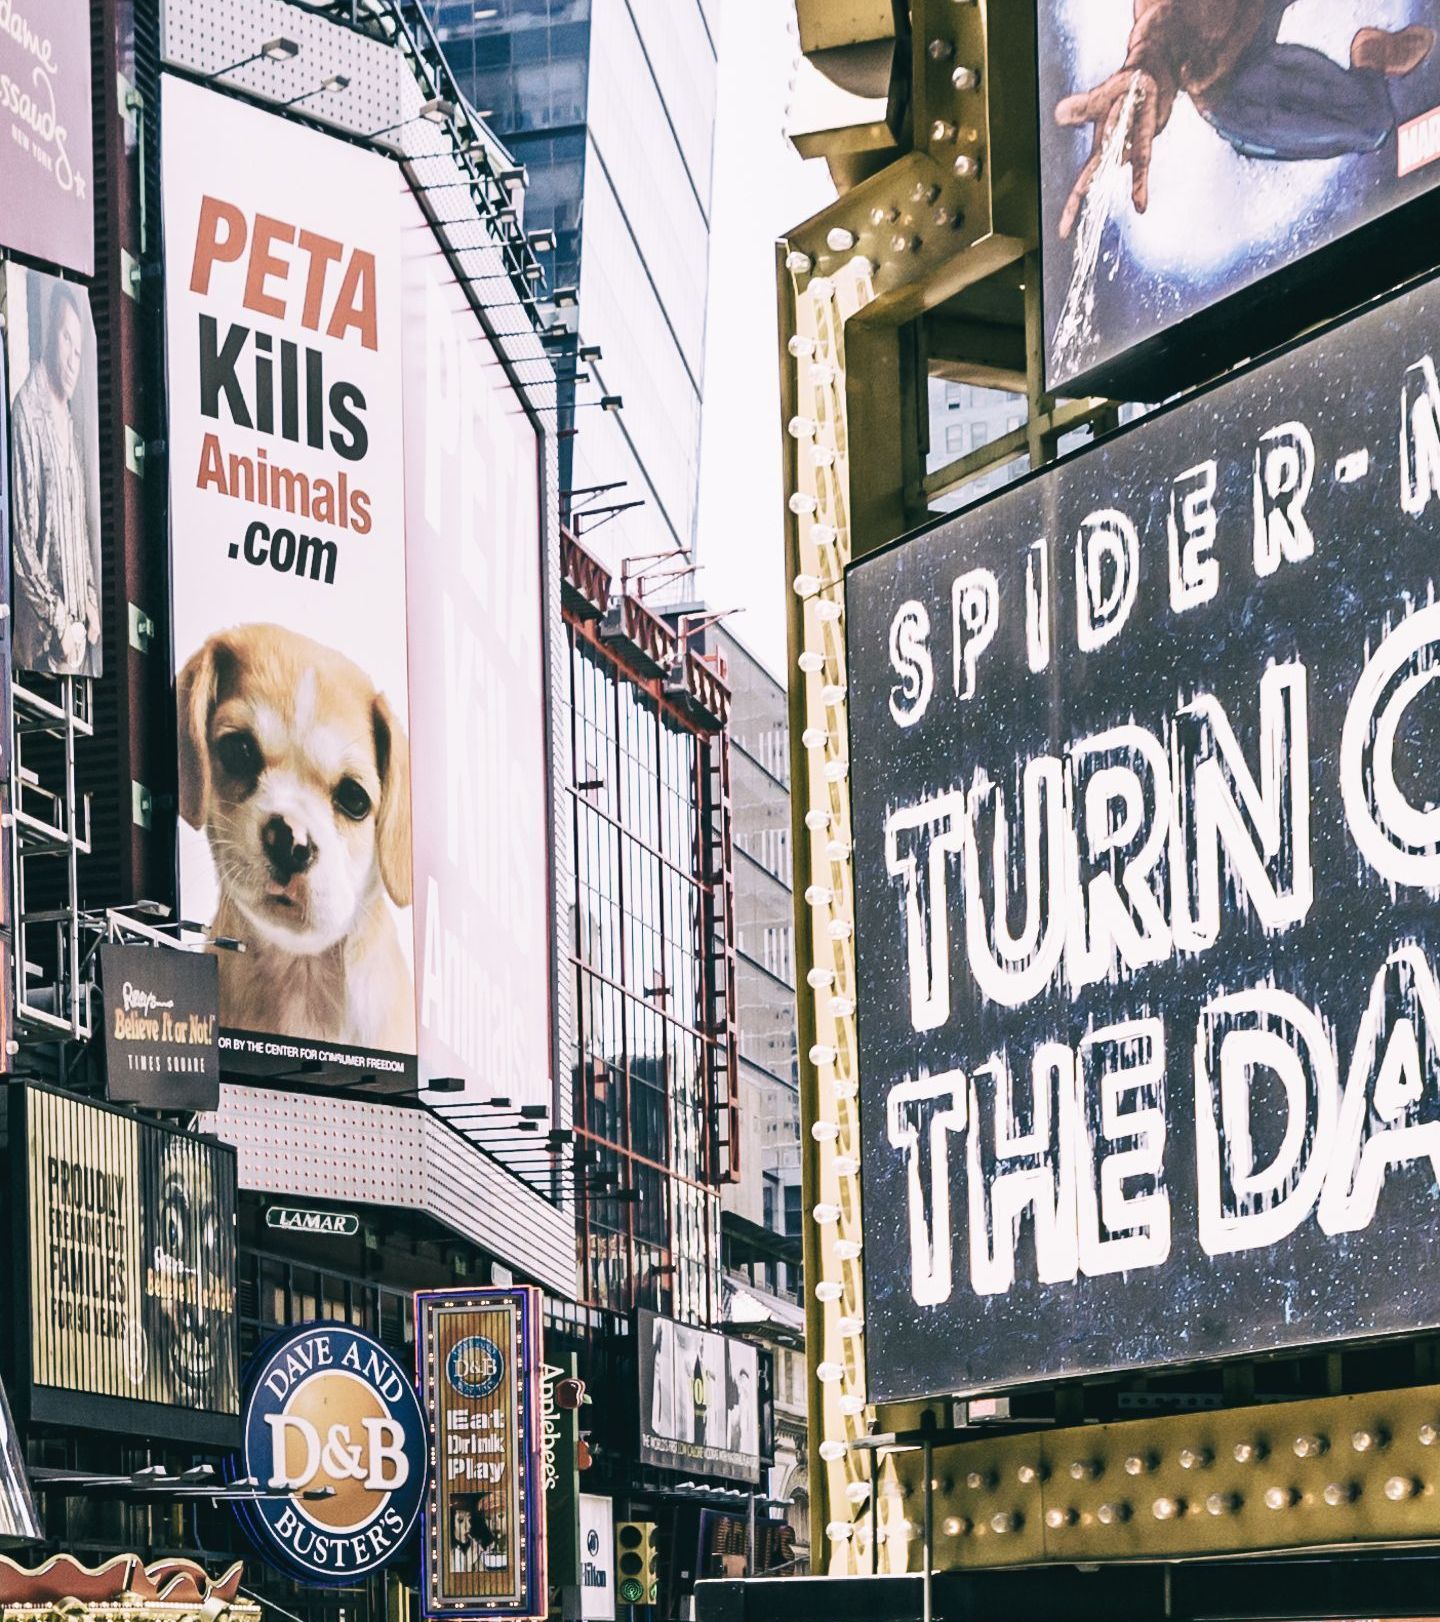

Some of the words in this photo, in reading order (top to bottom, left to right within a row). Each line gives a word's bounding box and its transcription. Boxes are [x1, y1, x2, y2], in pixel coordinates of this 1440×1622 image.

[189, 194, 378, 351] PETA
[198, 313, 369, 462] Kills
[196, 432, 373, 535] Animals
[227, 519, 338, 584] .com
[882, 656, 1314, 1031] TURN
[114, 1008, 159, 1042] Believe
[162, 1011, 173, 1042] It
[175, 1021, 187, 1043] or
[234, 1039, 245, 1051] BY
[246, 1040, 264, 1054] THE
[265, 1042, 299, 1058] CENTER
[300, 1048, 318, 1061] FOR
[366, 1056, 405, 1074] FREEDOM
[128, 1054, 160, 1072] TIMES
[167, 1056, 205, 1073] SQUARE
[48, 1155, 124, 1219] PROUDLY
[887, 1015, 1172, 1305] THE
[279, 1210, 347, 1232] LAMAR
[265, 1336, 333, 1402] DAVE
[342, 1341, 403, 1403] AND
[446, 1408, 506, 1430] Eat
[447, 1433, 506, 1455] Drink
[264, 1413, 410, 1490] D&B
[447, 1458, 506, 1483] Play
[274, 1506, 405, 1569] BUSTER'S
